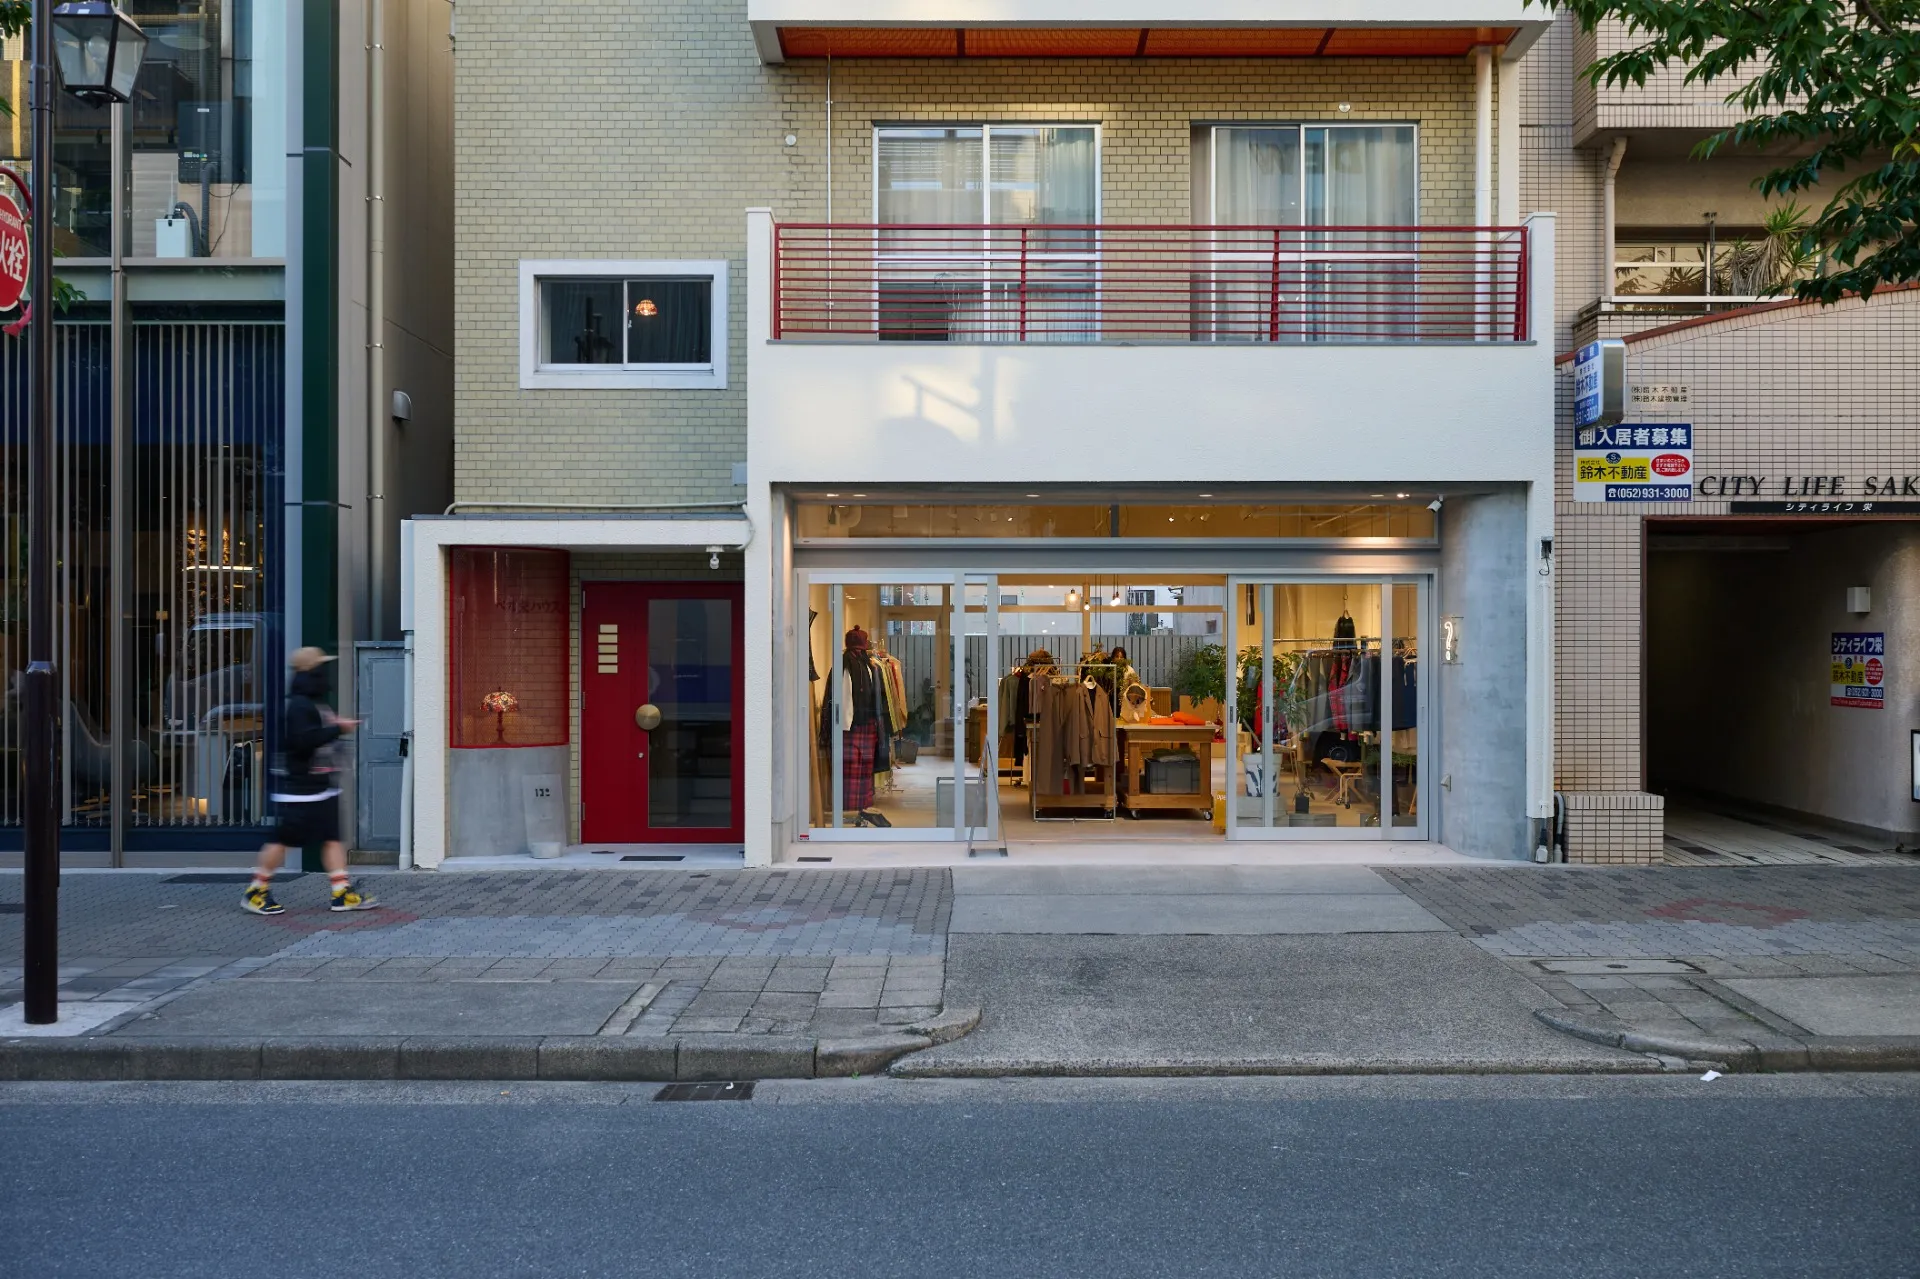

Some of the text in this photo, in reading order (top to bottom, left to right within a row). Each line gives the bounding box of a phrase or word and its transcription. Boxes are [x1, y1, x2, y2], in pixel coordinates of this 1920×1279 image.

[1579, 428, 1687, 446] 御入居者募集
[1580, 466, 1647, 479] 鈴木不動産
[1700, 476, 1765, 496] CITY
[1784, 476, 1845, 496] LIFE
[1785, 503, 1853, 511] シティライフ
[1833, 637, 1883, 653] シティライフ栄
